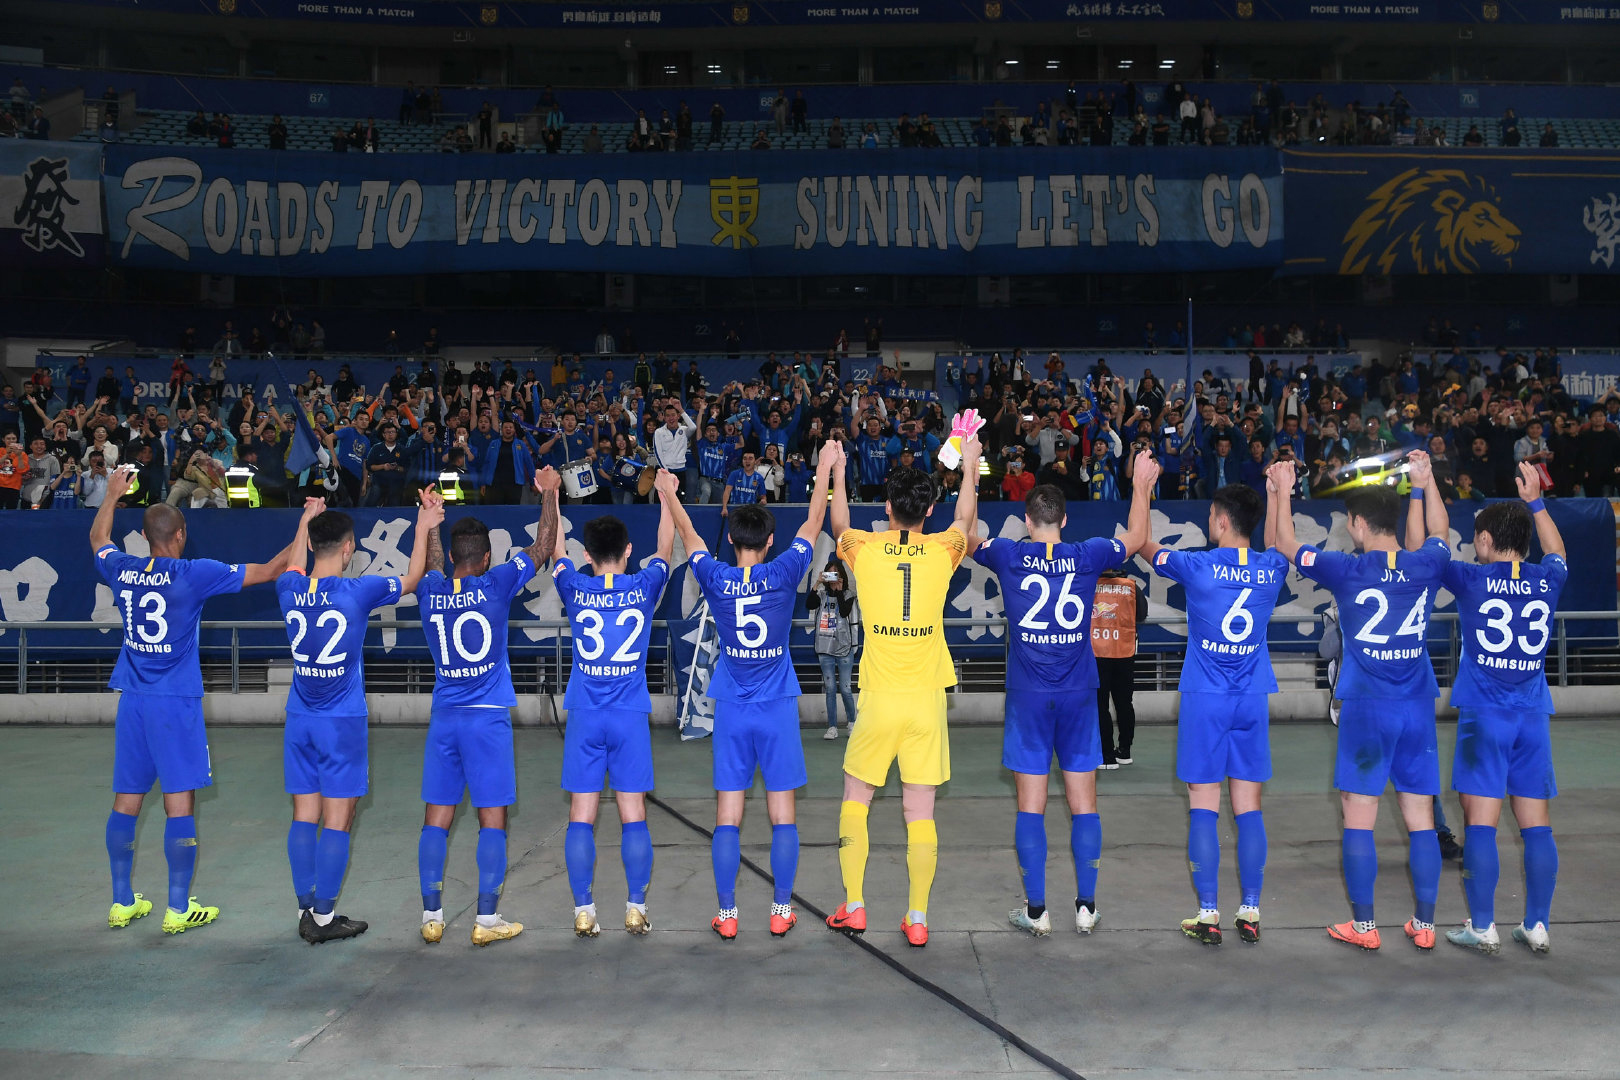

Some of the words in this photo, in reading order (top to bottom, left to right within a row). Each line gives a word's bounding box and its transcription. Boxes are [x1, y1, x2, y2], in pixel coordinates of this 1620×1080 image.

[298, 4, 328, 13] MORE
[334, 6, 362, 14] THAN
[378, 8, 414, 18] MATCH
[808, 8, 836, 16] MORE
[1385, 6, 1419, 14] MATCH
[310, 94, 323, 102] 67
[1461, 94, 1473, 104] 70
[121, 156, 337, 260] ROADS
[356, 177, 423, 250] TO
[454, 177, 683, 248] VICTORY
[794, 175, 983, 252] SUNING
[1016, 173, 1160, 248] LET'S
[1202, 172, 1271, 248] GO
[696, 324, 708, 335] 22
[854, 369, 868, 380] 22
[884, 542, 902, 556] GU
[907, 544, 926, 557] CH.
[1022, 555, 1076, 573] SANTINI
[118, 570, 172, 586] MIRANDA
[1212, 564, 1250, 584] YANG
[1257, 570, 1276, 584] B.Y.
[1380, 568, 1392, 582] JI
[1396, 570, 1410, 582] X.
[723, 580, 758, 596] ZHOU
[762, 577, 772, 590] Y.
[896, 562, 912, 621] 1
[1486, 577, 1532, 595] WANG
[1540, 579, 1552, 592] S.
[294, 592, 316, 607] WU
[320, 592, 333, 606] X.
[430, 589, 487, 610] TEIXEIRA
[574, 590, 614, 608] HUANG
[617, 588, 646, 606] Z.CH.
[1018, 572, 1084, 630] 26
[120, 590, 168, 644] 13
[736, 596, 768, 648] 5
[1221, 588, 1254, 642] 6
[1354, 586, 1428, 644] 24
[873, 624, 934, 637] SAMSUNG
[1092, 629, 1120, 640] 500
[1476, 598, 1550, 655] 33
[286, 610, 348, 664] 22
[430, 611, 492, 666] 10
[576, 608, 646, 662] 32
[1021, 632, 1082, 644] SAMSUNG
[726, 646, 782, 658] SAMSUNG
[1201, 639, 1260, 655] SAMSUN
[578, 663, 637, 676] SAMSUNG
[1477, 654, 1542, 670] SAMSUNG
[294, 666, 345, 678] AMSUNG
